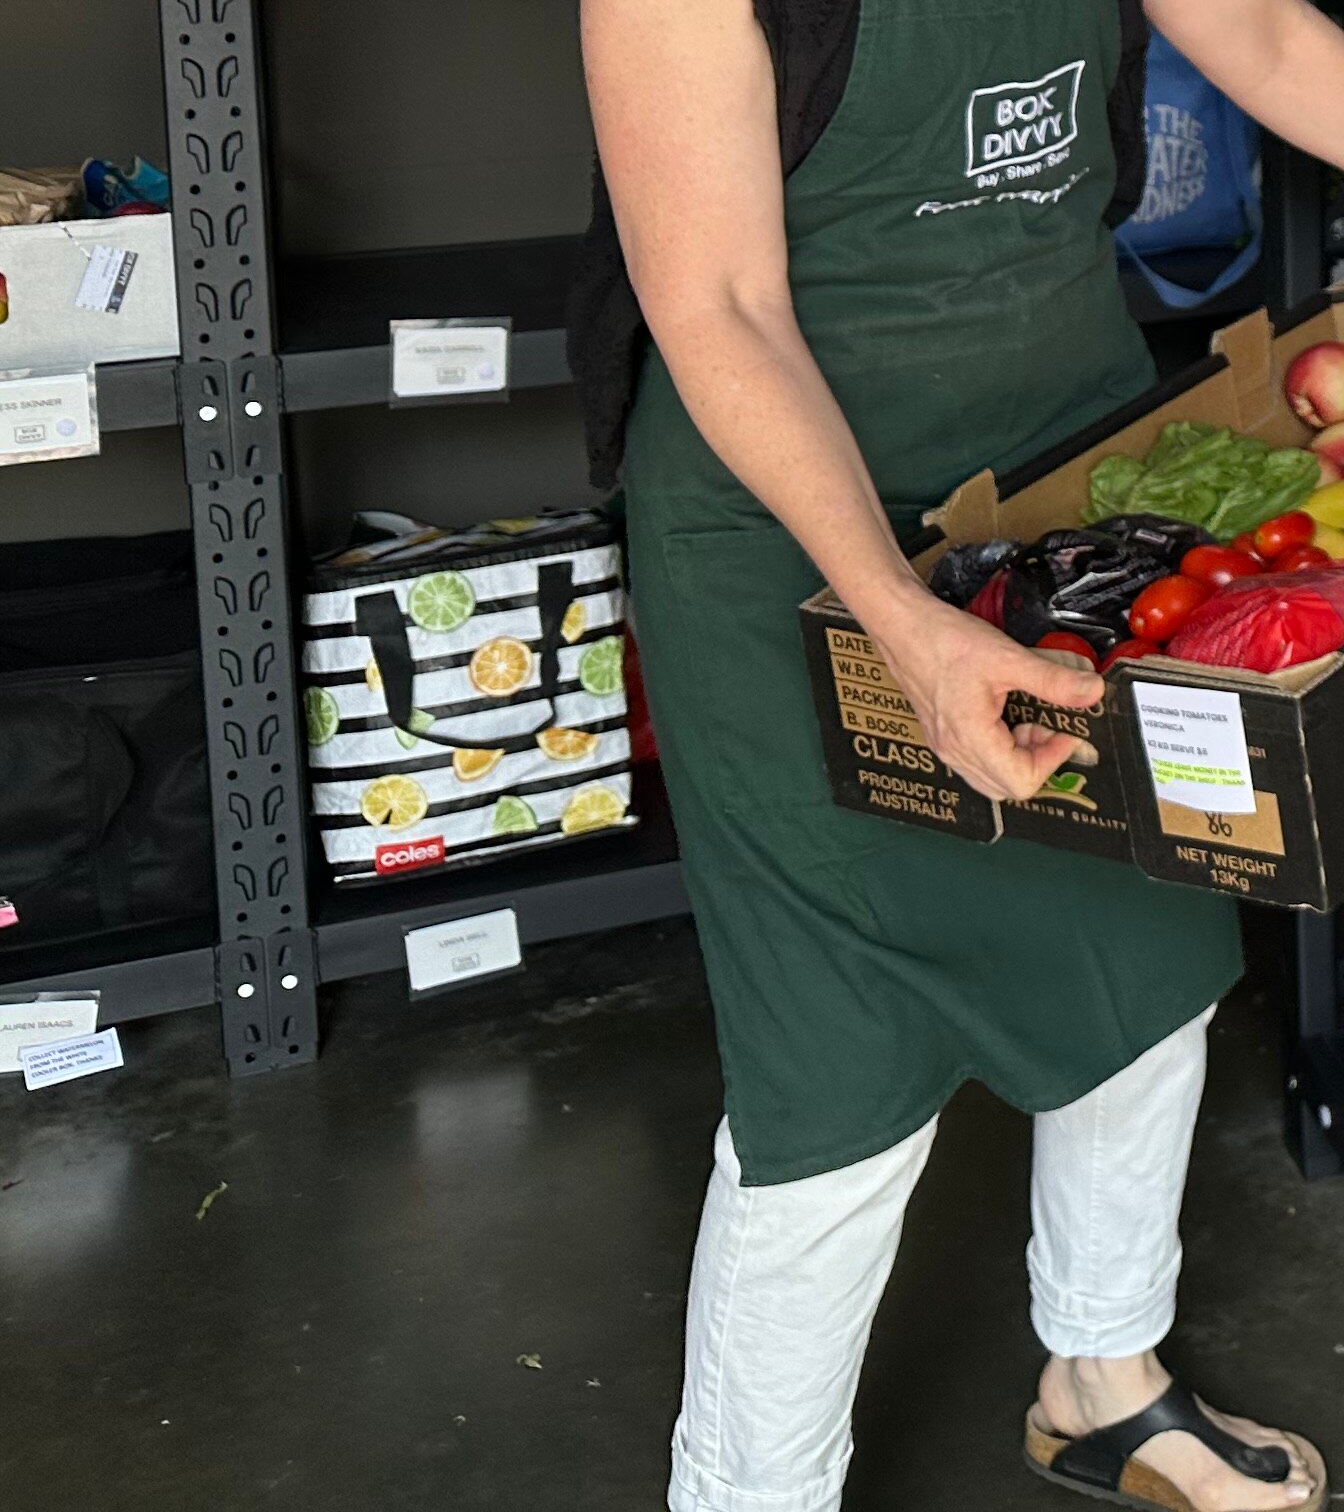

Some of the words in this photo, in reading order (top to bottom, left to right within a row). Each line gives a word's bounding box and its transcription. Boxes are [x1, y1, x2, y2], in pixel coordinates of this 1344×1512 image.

[997, 87, 1057, 127] BOX
[1153, 104, 1204, 139] THE
[983, 112, 1063, 161] DIVVY
[832, 633, 875, 655] DATE
[1007, 703, 1091, 738] PEARS
[1141, 704, 1180, 717] COOKING
[1181, 709, 1229, 722] TOMATOES
[1143, 719, 1186, 733] VERONICA
[853, 734, 936, 774] CLASS
[858, 769, 934, 798] PRODUCT
[938, 789, 960, 806] OF
[869, 791, 957, 823] AUSTRALIA
[1071, 810, 1128, 832] QUALITY
[380, 844, 441, 867] coles
[1176, 845, 1209, 864] NET
[1212, 851, 1277, 878] WEIGHT
[1209, 868, 1251, 893] 13Kg
